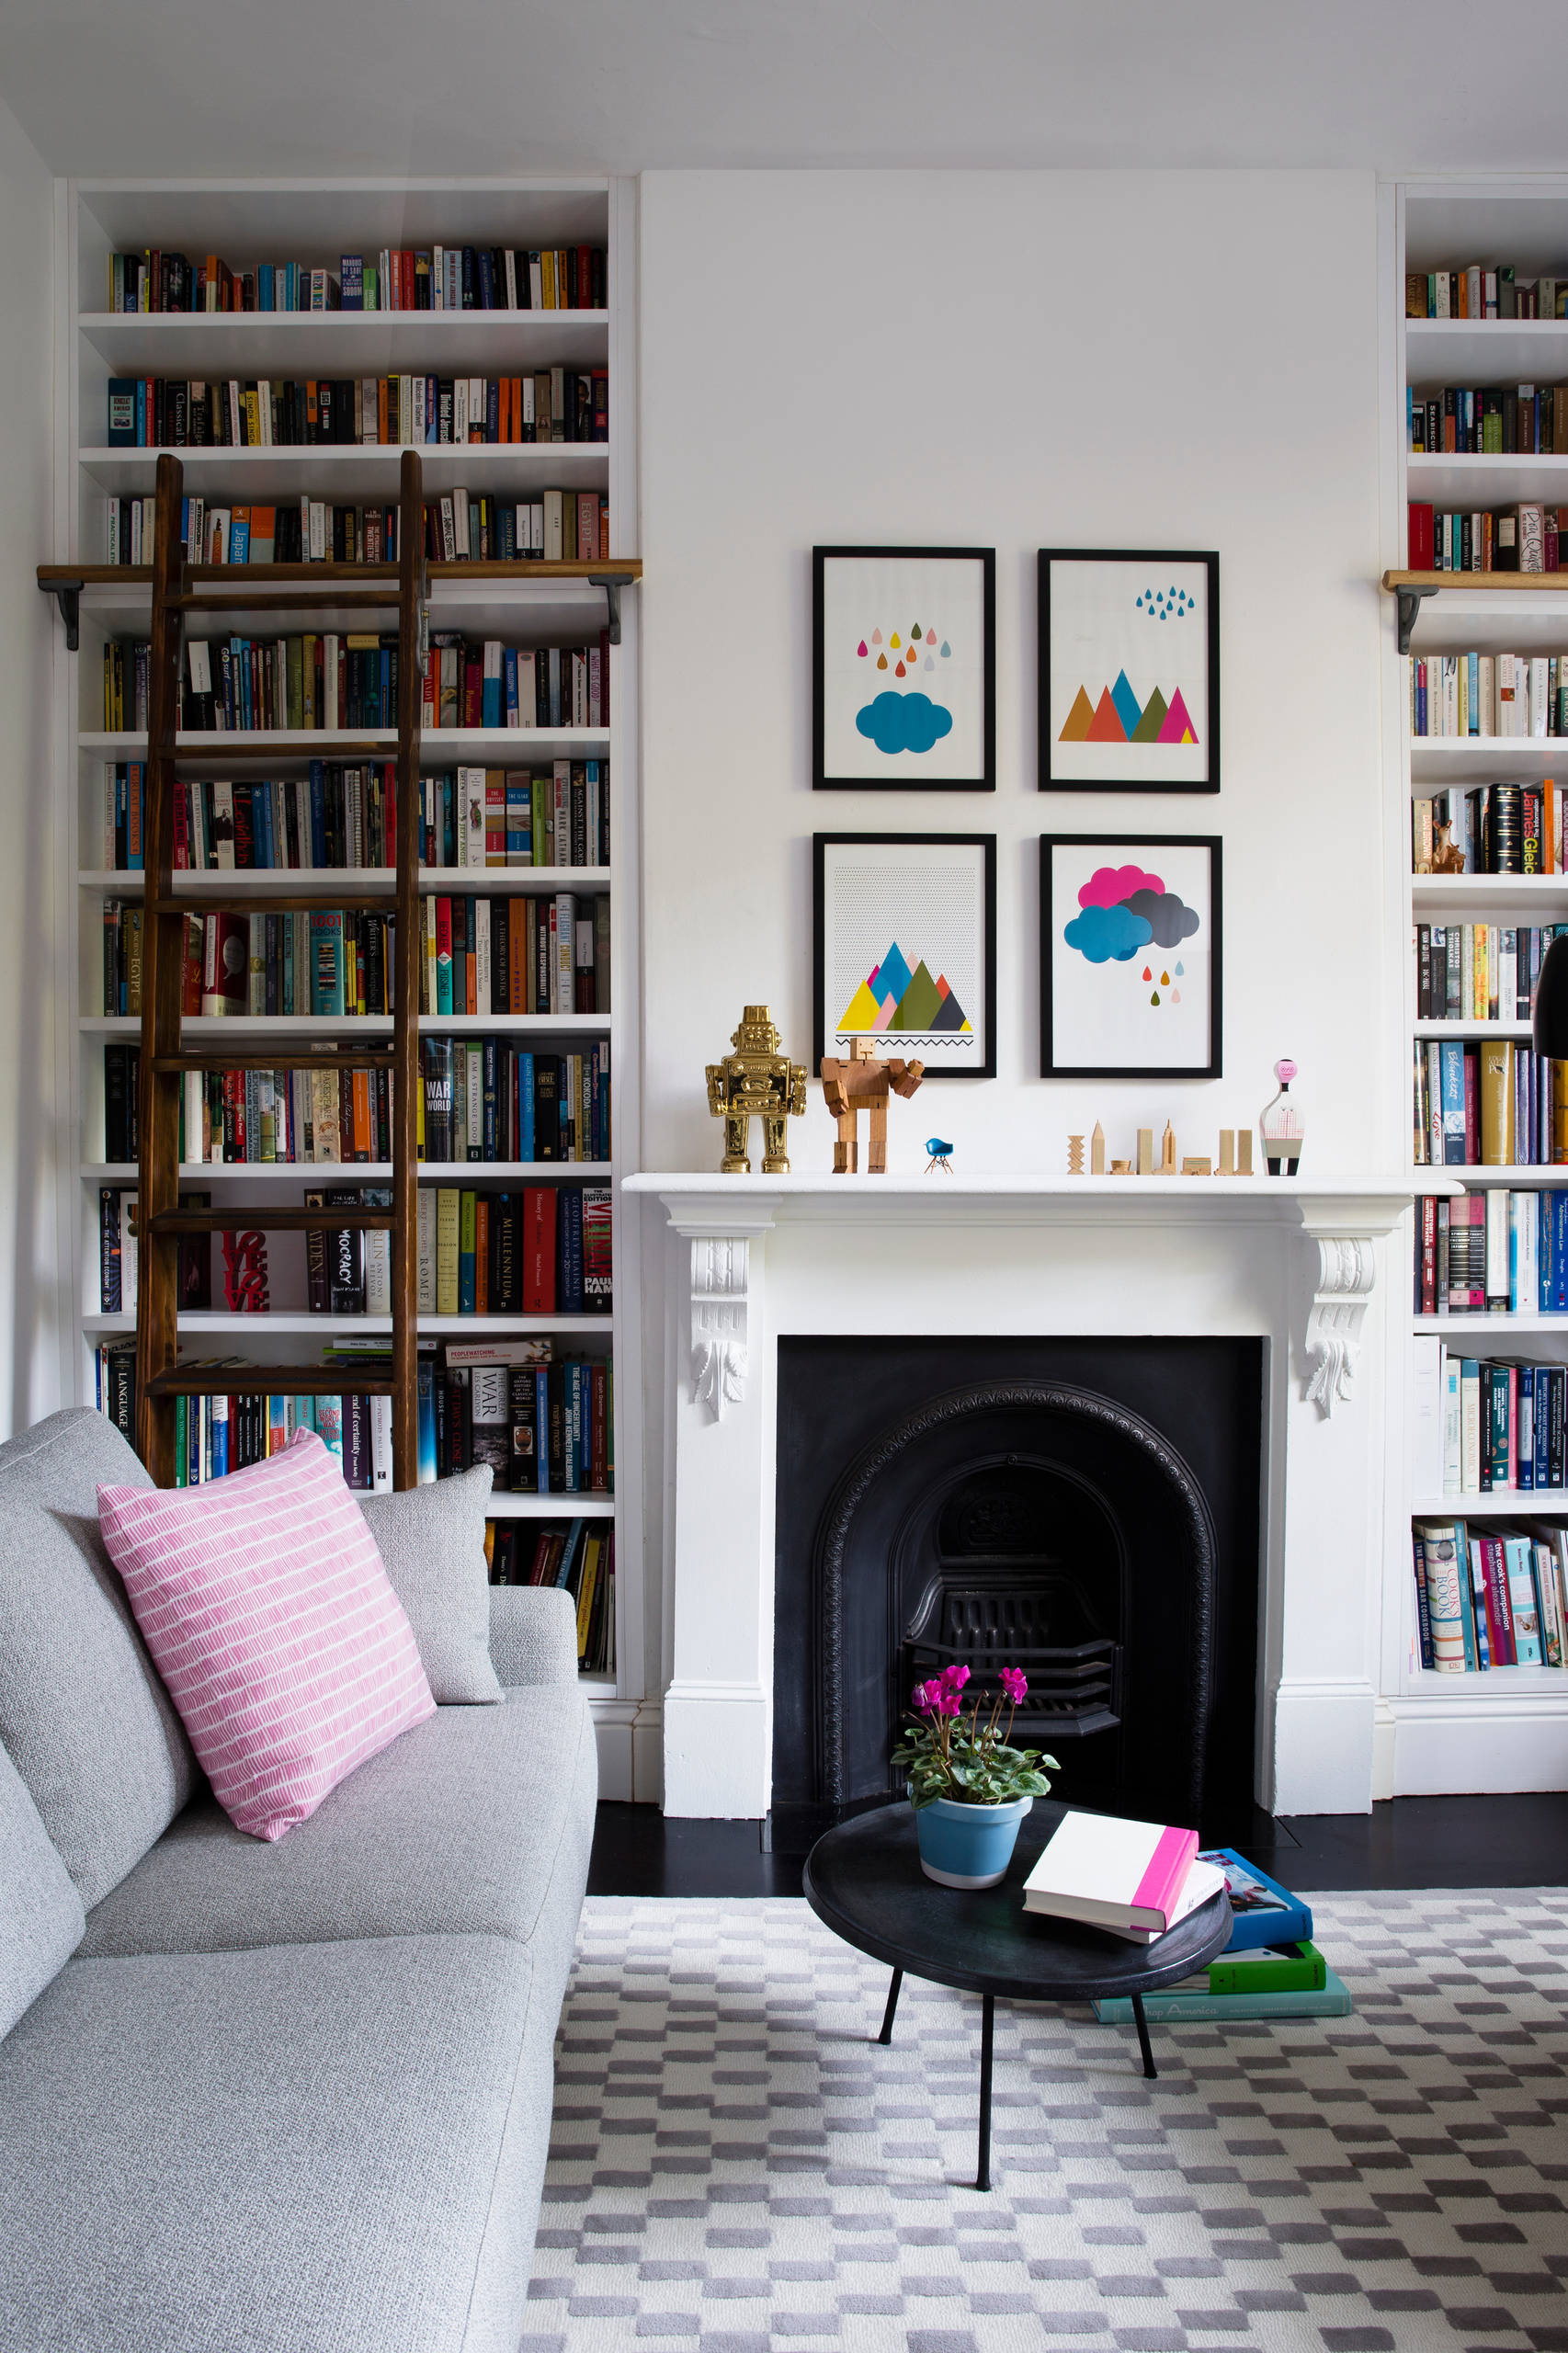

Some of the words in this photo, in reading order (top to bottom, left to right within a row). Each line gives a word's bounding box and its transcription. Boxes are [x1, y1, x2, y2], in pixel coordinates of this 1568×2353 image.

[176, 392, 185, 436] Classical
[415, 404, 423, 427] Gladwell
[440, 393, 451, 418] Divided
[439, 418, 451, 443] Jerusal
[581, 502, 592, 544] EGYPT
[1527, 512, 1541, 535] Don
[234, 529, 246, 564] Japan
[591, 655, 599, 674] WHAT
[591, 681, 599, 703] GOOD?
[131, 773, 140, 807] GREAT
[1422, 814, 1430, 831] DAN
[1523, 791, 1536, 838] James
[131, 811, 140, 847] BOOKS
[1422, 831, 1431, 859] BROWN
[1523, 837, 1539, 874] Gleic
[311, 915, 342, 927] 1001
[560, 914, 570, 943] FLAGRANT
[539, 926, 547, 951] WITHOUT
[499, 956, 506, 966] OF
[560, 944, 571, 972] CONDUCT
[131, 959, 141, 995] EGYPT
[439, 969, 449, 996] POSNER
[499, 969, 507, 996] JUSTICE
[539, 953, 547, 996] RESPONSIBILITY
[471, 1061, 478, 1074] AM
[1448, 1051, 1460, 1099] Blankets
[324, 1070, 333, 1119] HAKESPEARE
[426, 1081, 451, 1099] WAR
[583, 1077, 592, 1109] KOKODA
[426, 1099, 451, 1111] WORLD
[471, 1122, 479, 1143] LOOP
[535, 1193, 543, 1212] History
[572, 1196, 580, 1248] GEOFFREY
[309, 1229, 324, 1272] AYDEN
[588, 1202, 612, 1273] VIETNAM
[338, 1229, 353, 1285] MOCRACY
[501, 1217, 512, 1299] MILLENNIUM
[419, 1258, 428, 1300] ROME
[573, 1254, 581, 1298] BLAINEY
[497, 1373, 506, 1388] THE
[118, 1372, 129, 1427] LANGUAGE
[352, 1395, 361, 1409] end
[482, 1373, 497, 1417] WAR
[497, 1391, 506, 1416] GREAT
[573, 1392, 580, 1400] OF
[352, 1411, 362, 1419] of
[551, 1404, 560, 1427] mainly
[564, 1407, 573, 1425] JOHN
[351, 1420, 362, 1455] certainty
[1486, 1543, 1498, 1585] stephanie
[1494, 1542, 1502, 1558] the
[1495, 1559, 1506, 1585] cook's
[1419, 1589, 1427, 1603] BAR
[1436, 1576, 1450, 1617] BOOK
[1447, 1568, 1460, 1618] COOK'S
[1490, 1586, 1503, 1626] alexander
[1498, 1585, 1510, 1631] companion
[1420, 1604, 1429, 1642] COOKBOOK
[1167, 2003, 1218, 2016] America
